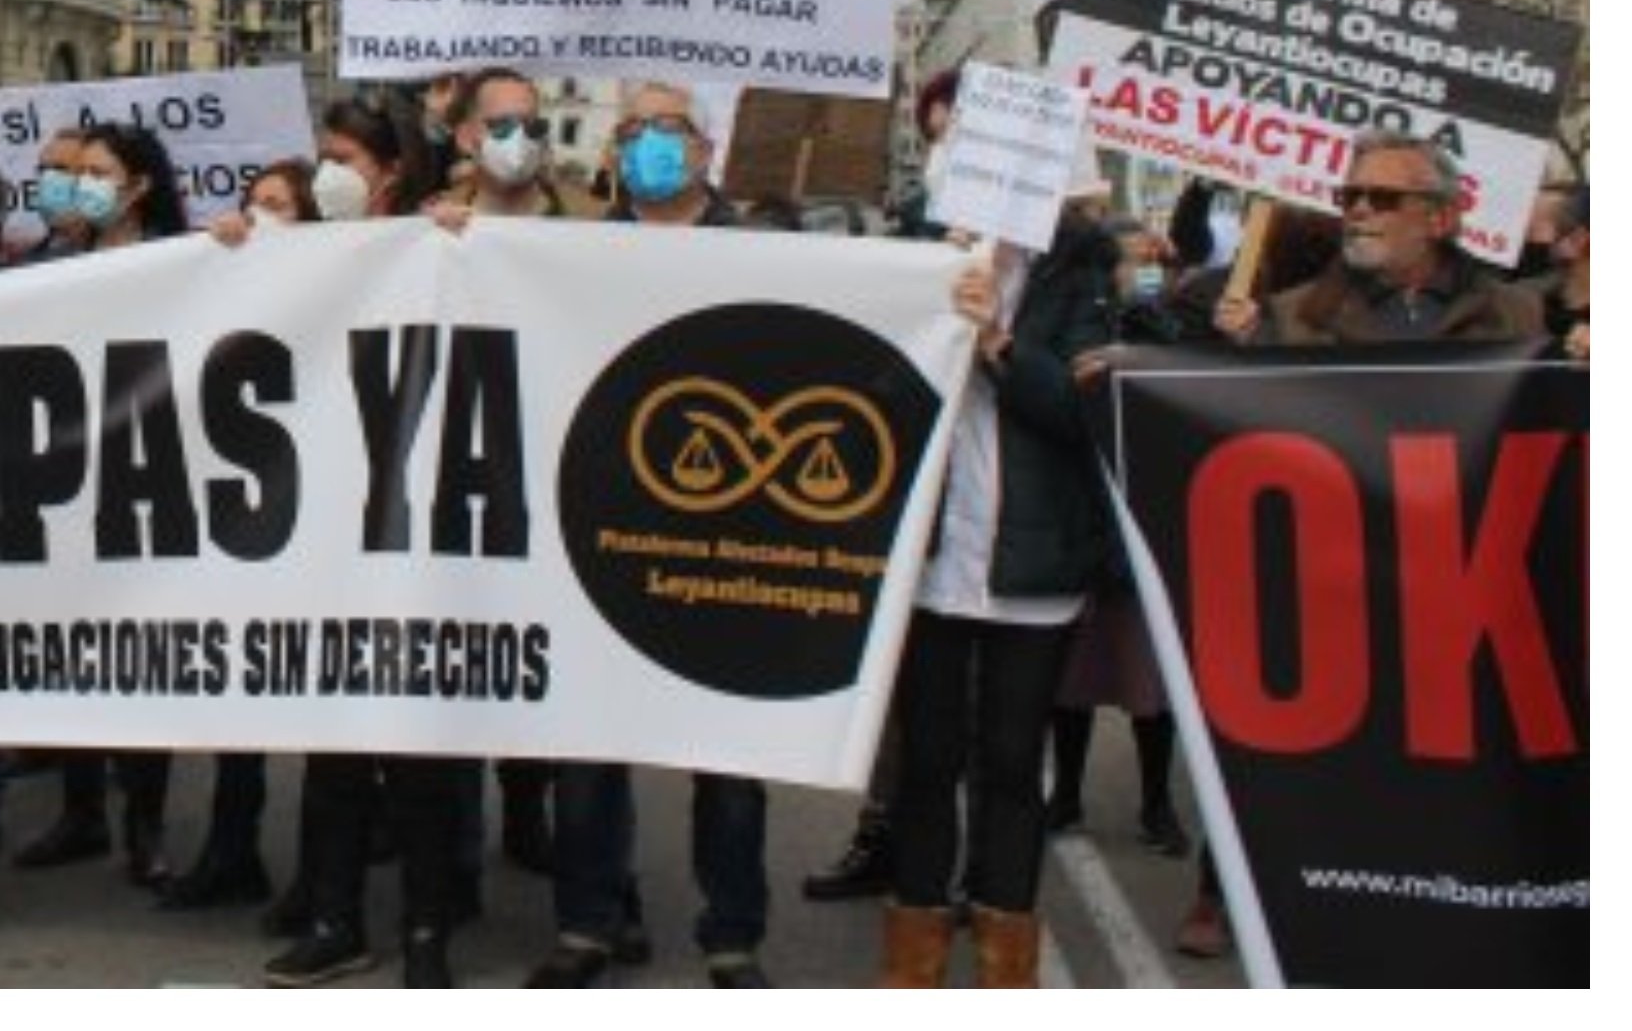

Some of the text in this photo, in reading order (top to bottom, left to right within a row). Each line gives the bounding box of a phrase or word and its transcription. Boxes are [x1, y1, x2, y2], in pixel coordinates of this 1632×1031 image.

[347, 36, 540, 61] TRABAJANDO
[550, 36, 567, 56] Y
[760, 49, 885, 82] AYUDAS
[1119, 37, 1414, 137] APOYANDO
[1429, 117, 1465, 158] A
[1163, 2, 1448, 104] Leyantiocupas
[1285, 0, 1330, 32] de
[1337, 12, 1556, 93] Ocupación
[347, 323, 530, 559] YA
[1188, 431, 1590, 760] OK
[243, 618, 310, 698] SIN
[315, 617, 552, 703] DERECHOS
